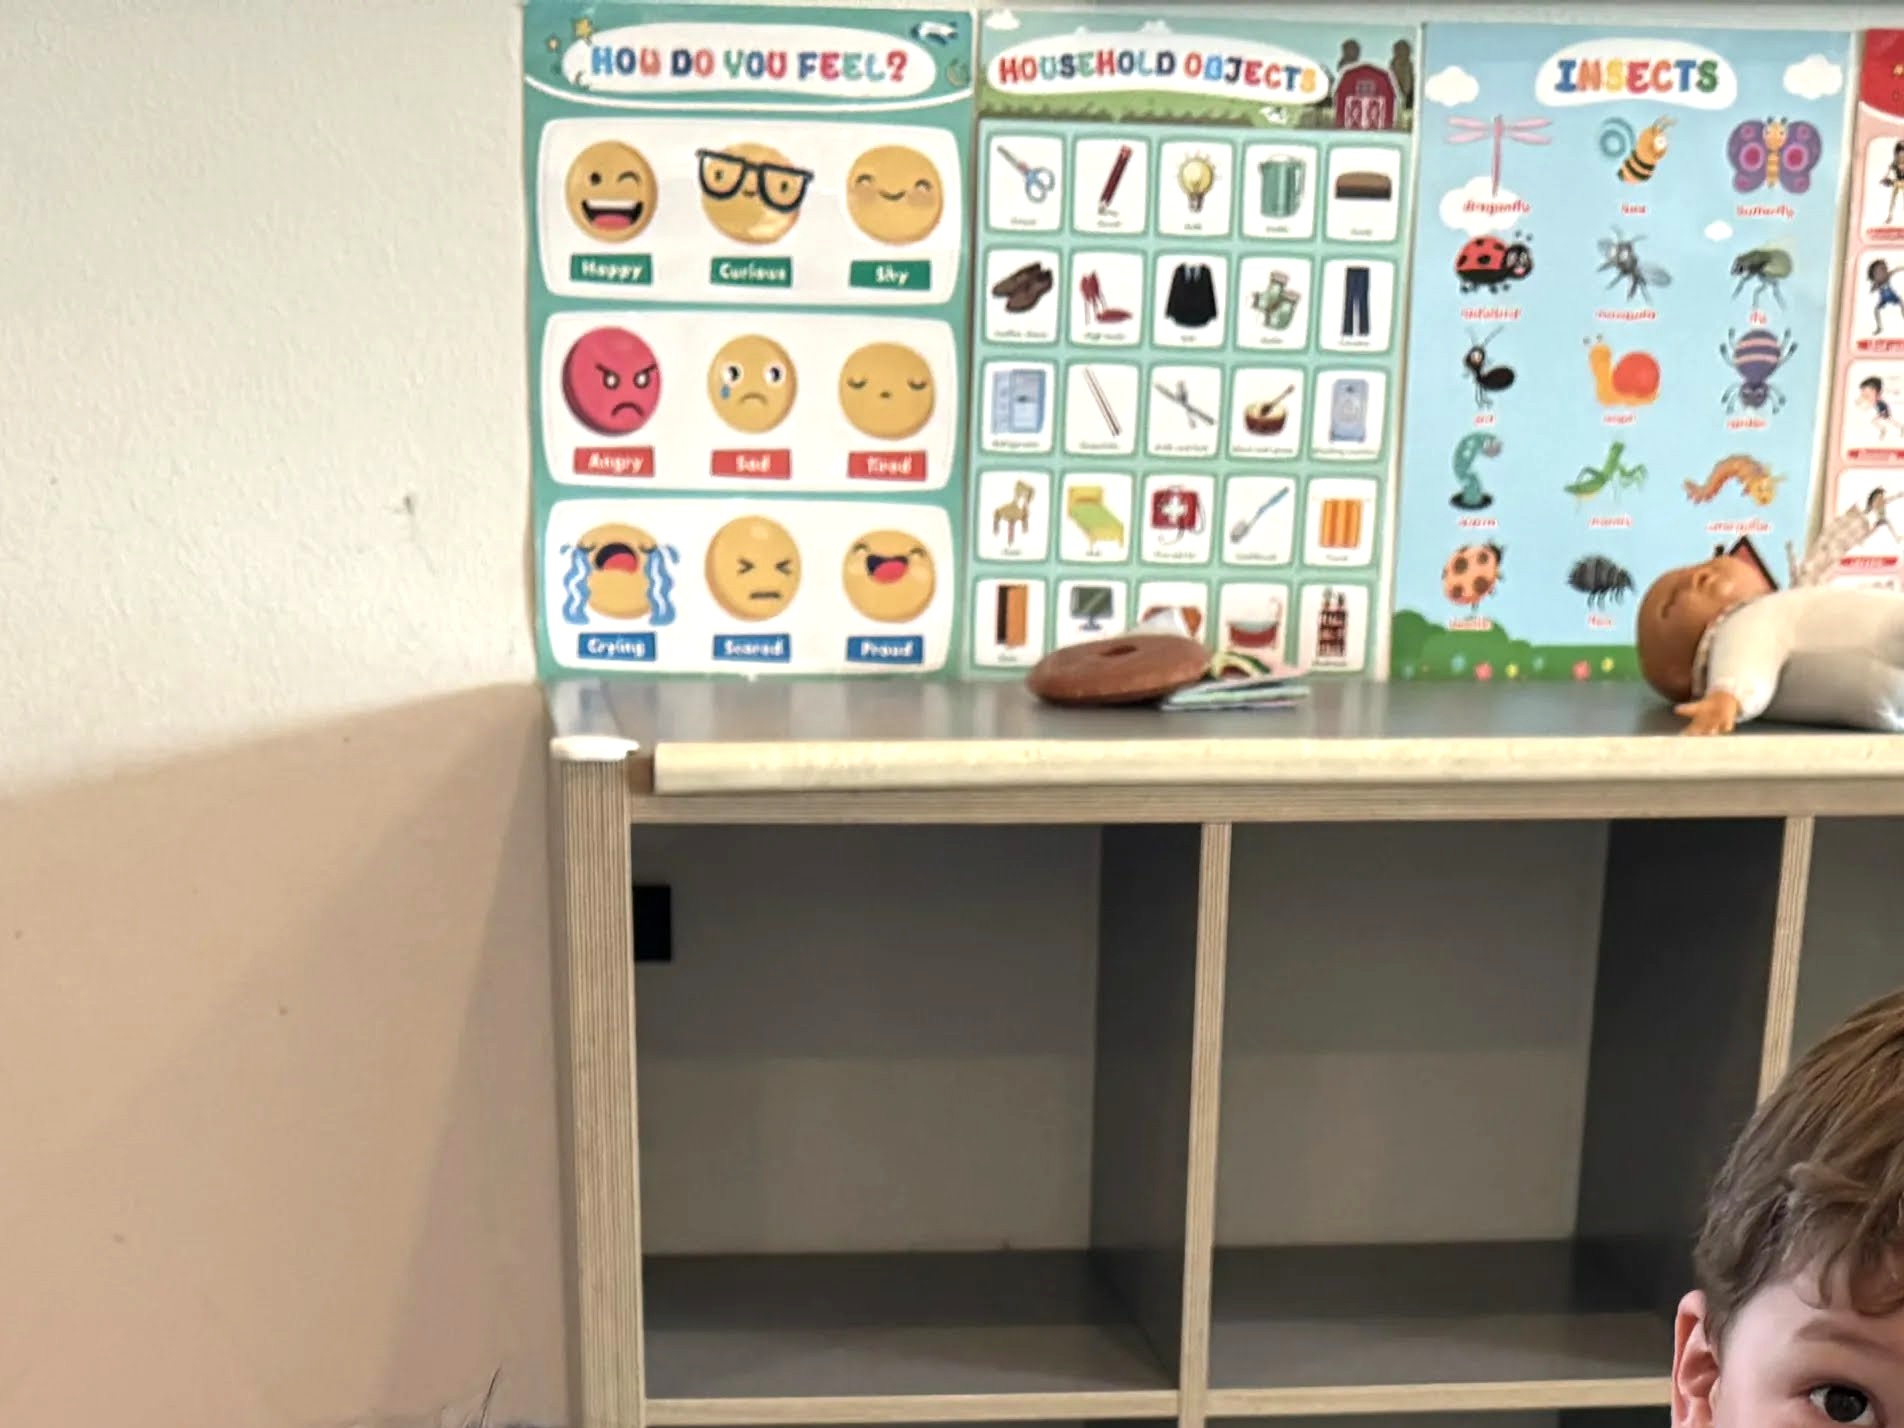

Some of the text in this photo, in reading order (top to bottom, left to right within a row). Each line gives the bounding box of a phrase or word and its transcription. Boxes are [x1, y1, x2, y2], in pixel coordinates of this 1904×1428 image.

[591, 46, 908, 82] HOW DO YOU FEEL?
[998, 50, 1317, 93] HOUSEHOLD OBJECTS
[1554, 58, 1719, 94] INSECTS
[581, 260, 643, 281] Happy
[719, 263, 788, 281] Curious
[875, 265, 910, 285] Shy
[588, 451, 644, 473] Angry
[735, 455, 772, 472] Sad
